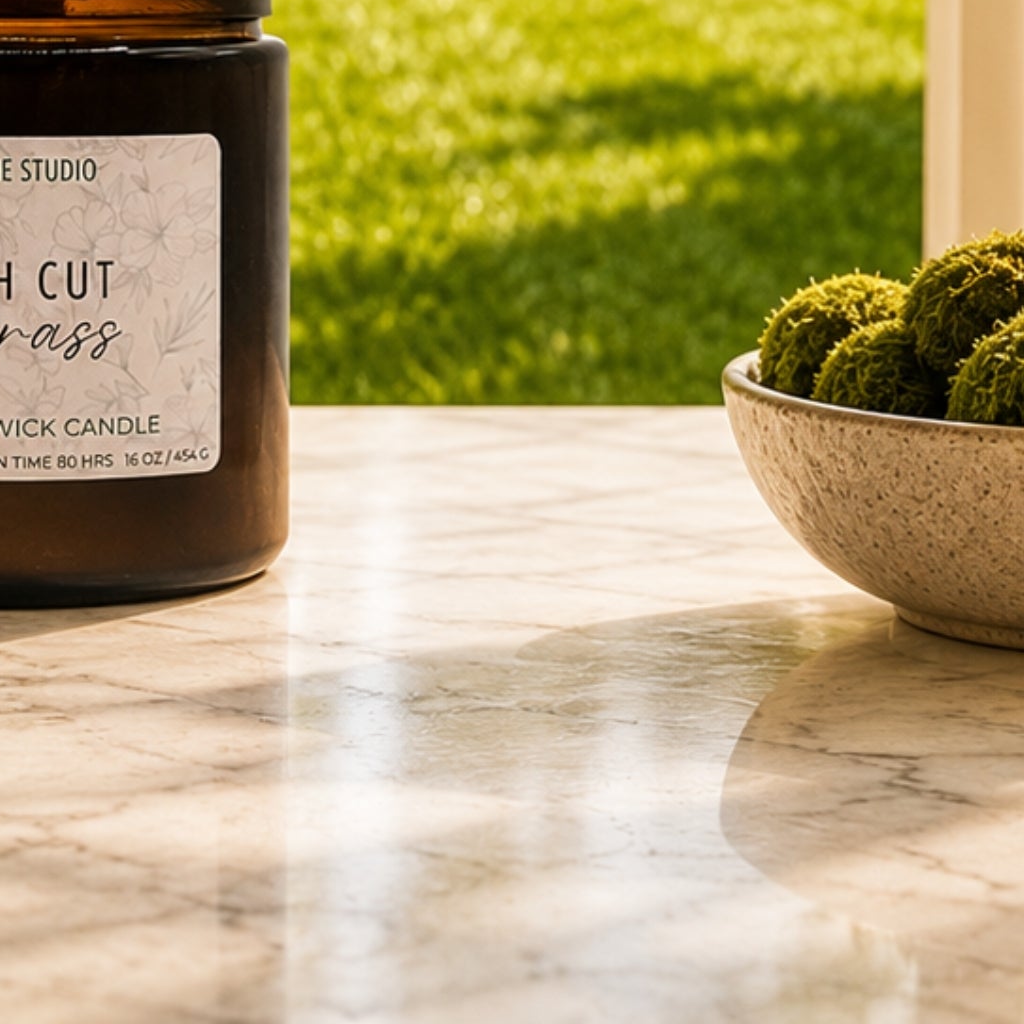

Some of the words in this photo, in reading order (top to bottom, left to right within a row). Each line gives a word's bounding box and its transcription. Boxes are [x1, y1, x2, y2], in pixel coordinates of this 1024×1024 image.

[21, 158, 97, 182] STUDIO
[38, 261, 115, 299] CUT
[64, 414, 160, 437] CANDLE
[12, 455, 52, 470] TIME
[57, 455, 77, 469] 80
[81, 454, 114, 468] HRS
[124, 453, 139, 466] 16
